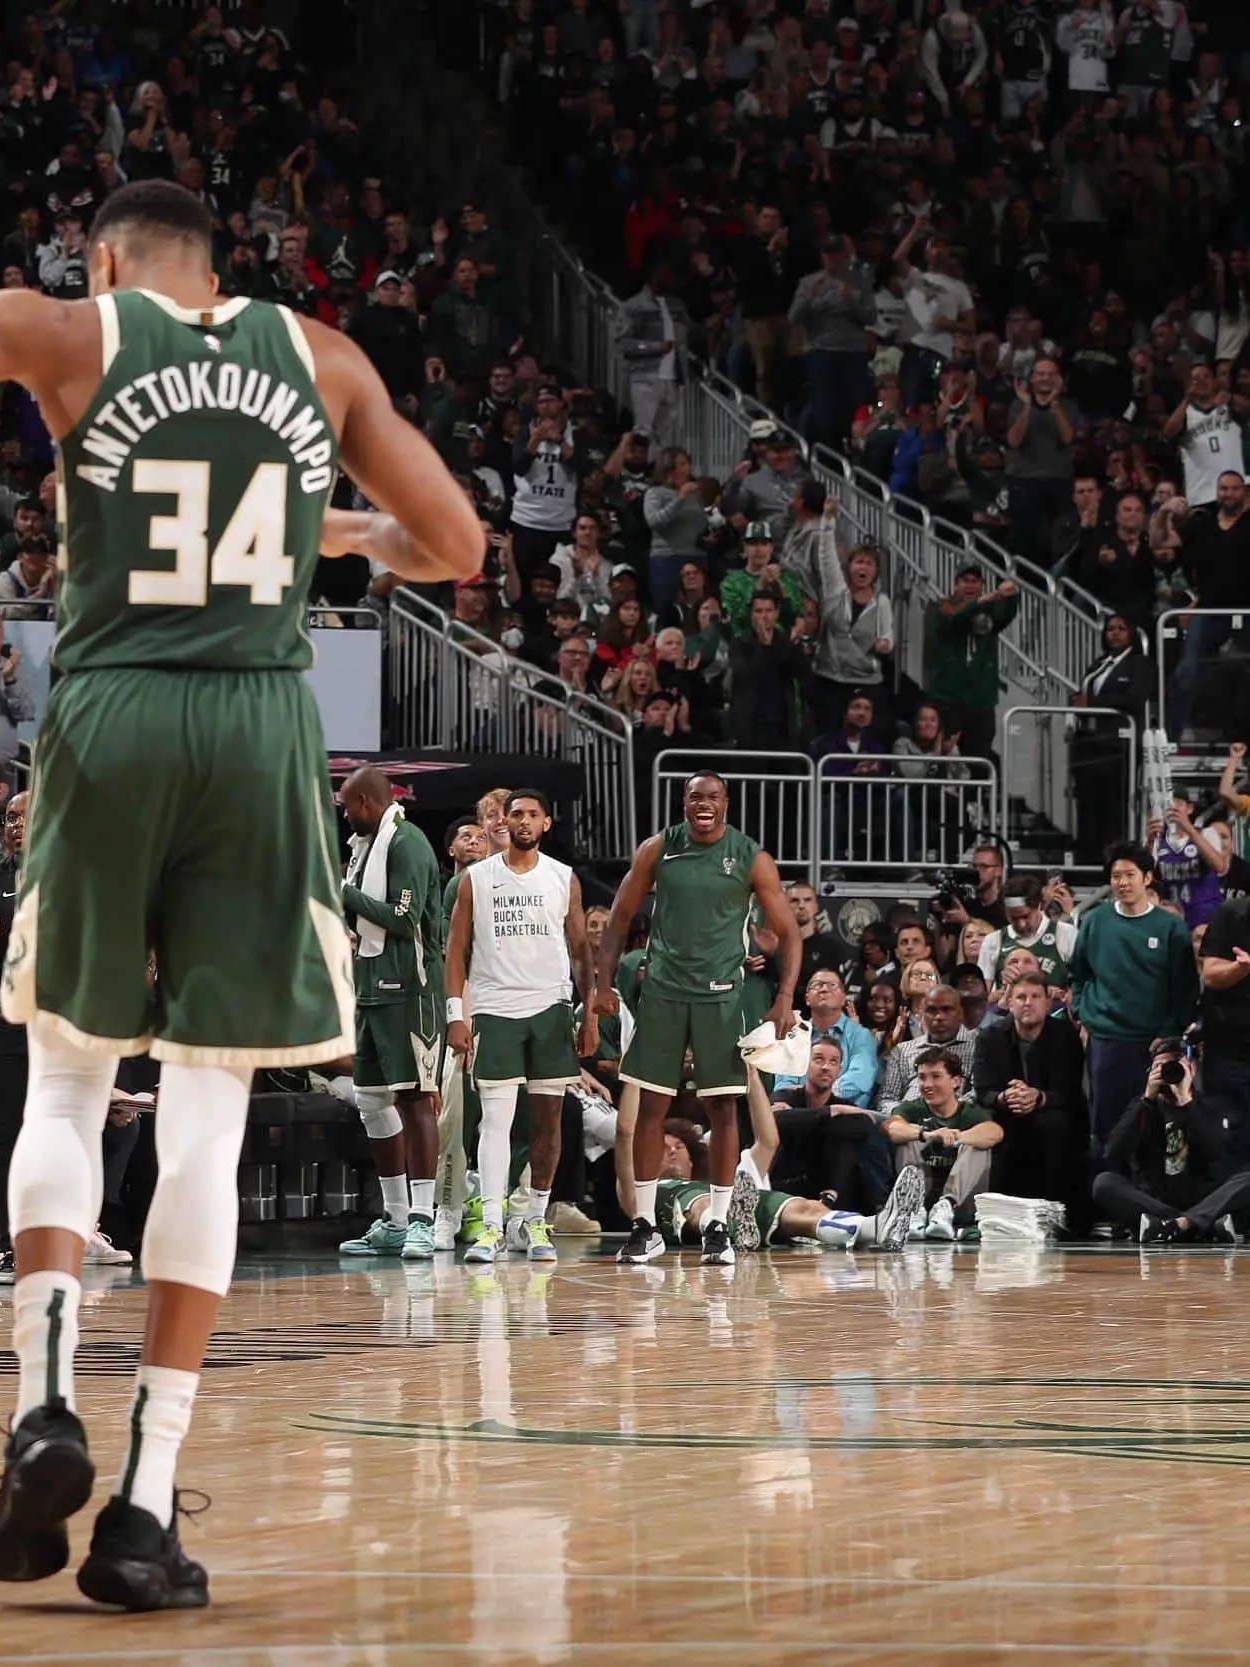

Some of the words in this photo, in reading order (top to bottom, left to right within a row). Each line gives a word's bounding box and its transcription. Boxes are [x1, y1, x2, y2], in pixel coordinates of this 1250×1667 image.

[211, 166, 231, 185] 34
[76, 361, 332, 494] ANTETOKOUNMPO
[1208, 437, 1219, 453] 0
[547, 465, 555, 485] 1
[532, 485, 565, 498] STATE
[128, 458, 295, 606] 34
[492, 895, 543, 909] MILWAUKEE
[492, 911, 523, 923] BUCKS
[494, 924, 549, 938] BASKETBALL
